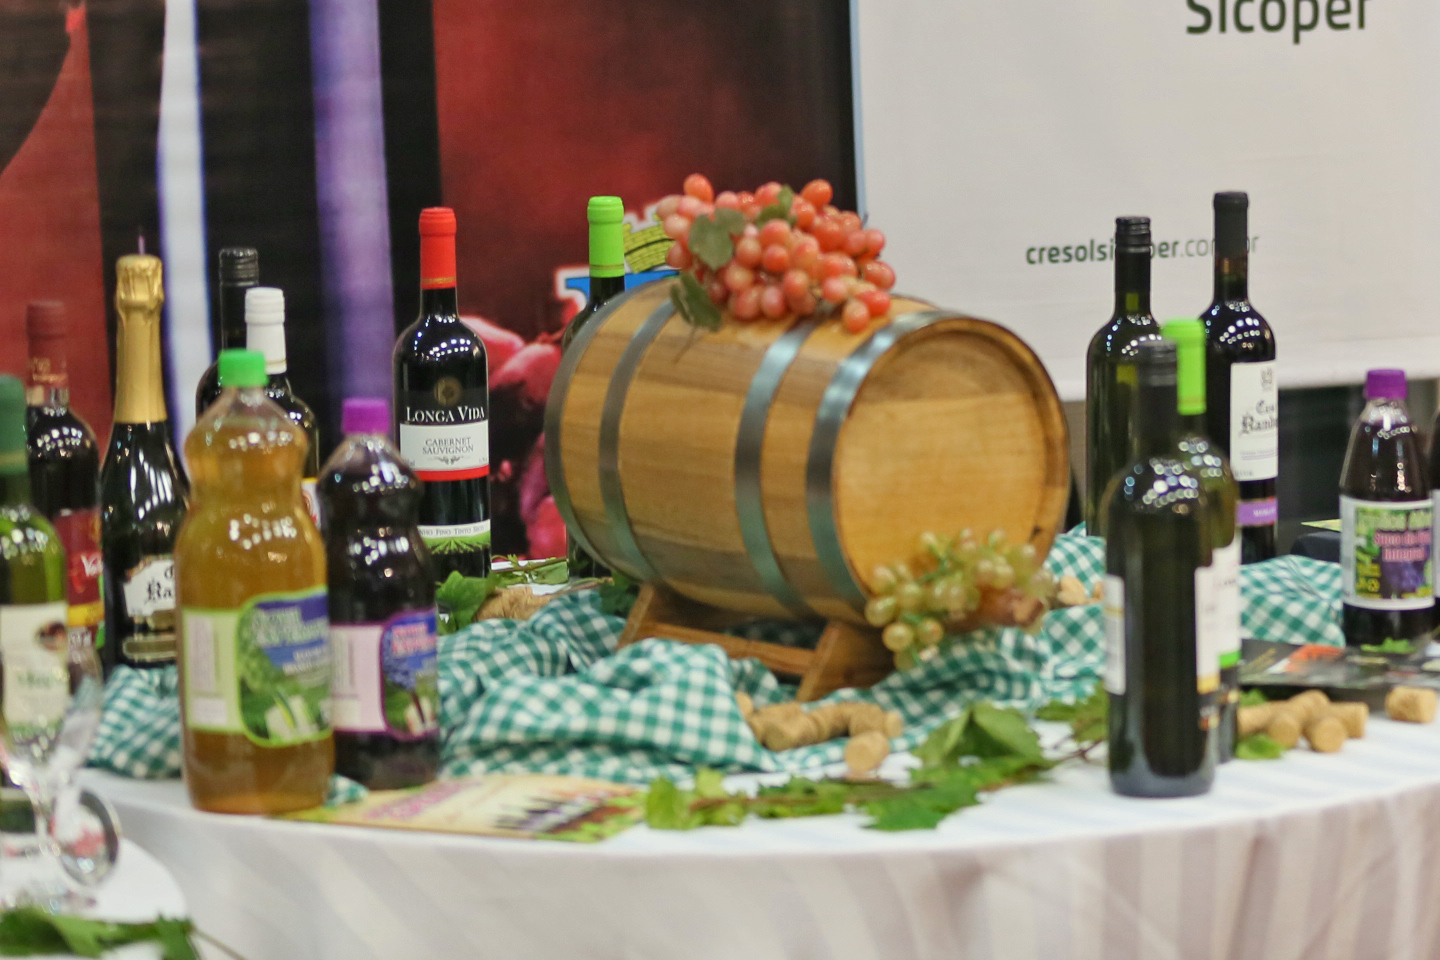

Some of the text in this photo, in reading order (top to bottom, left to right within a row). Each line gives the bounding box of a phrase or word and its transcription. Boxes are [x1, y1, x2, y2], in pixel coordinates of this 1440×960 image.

[406, 406, 485, 423] LONGA VIDA
[425, 437, 472, 447] CABERNET
[422, 446, 474, 455] SAUVIGNON
